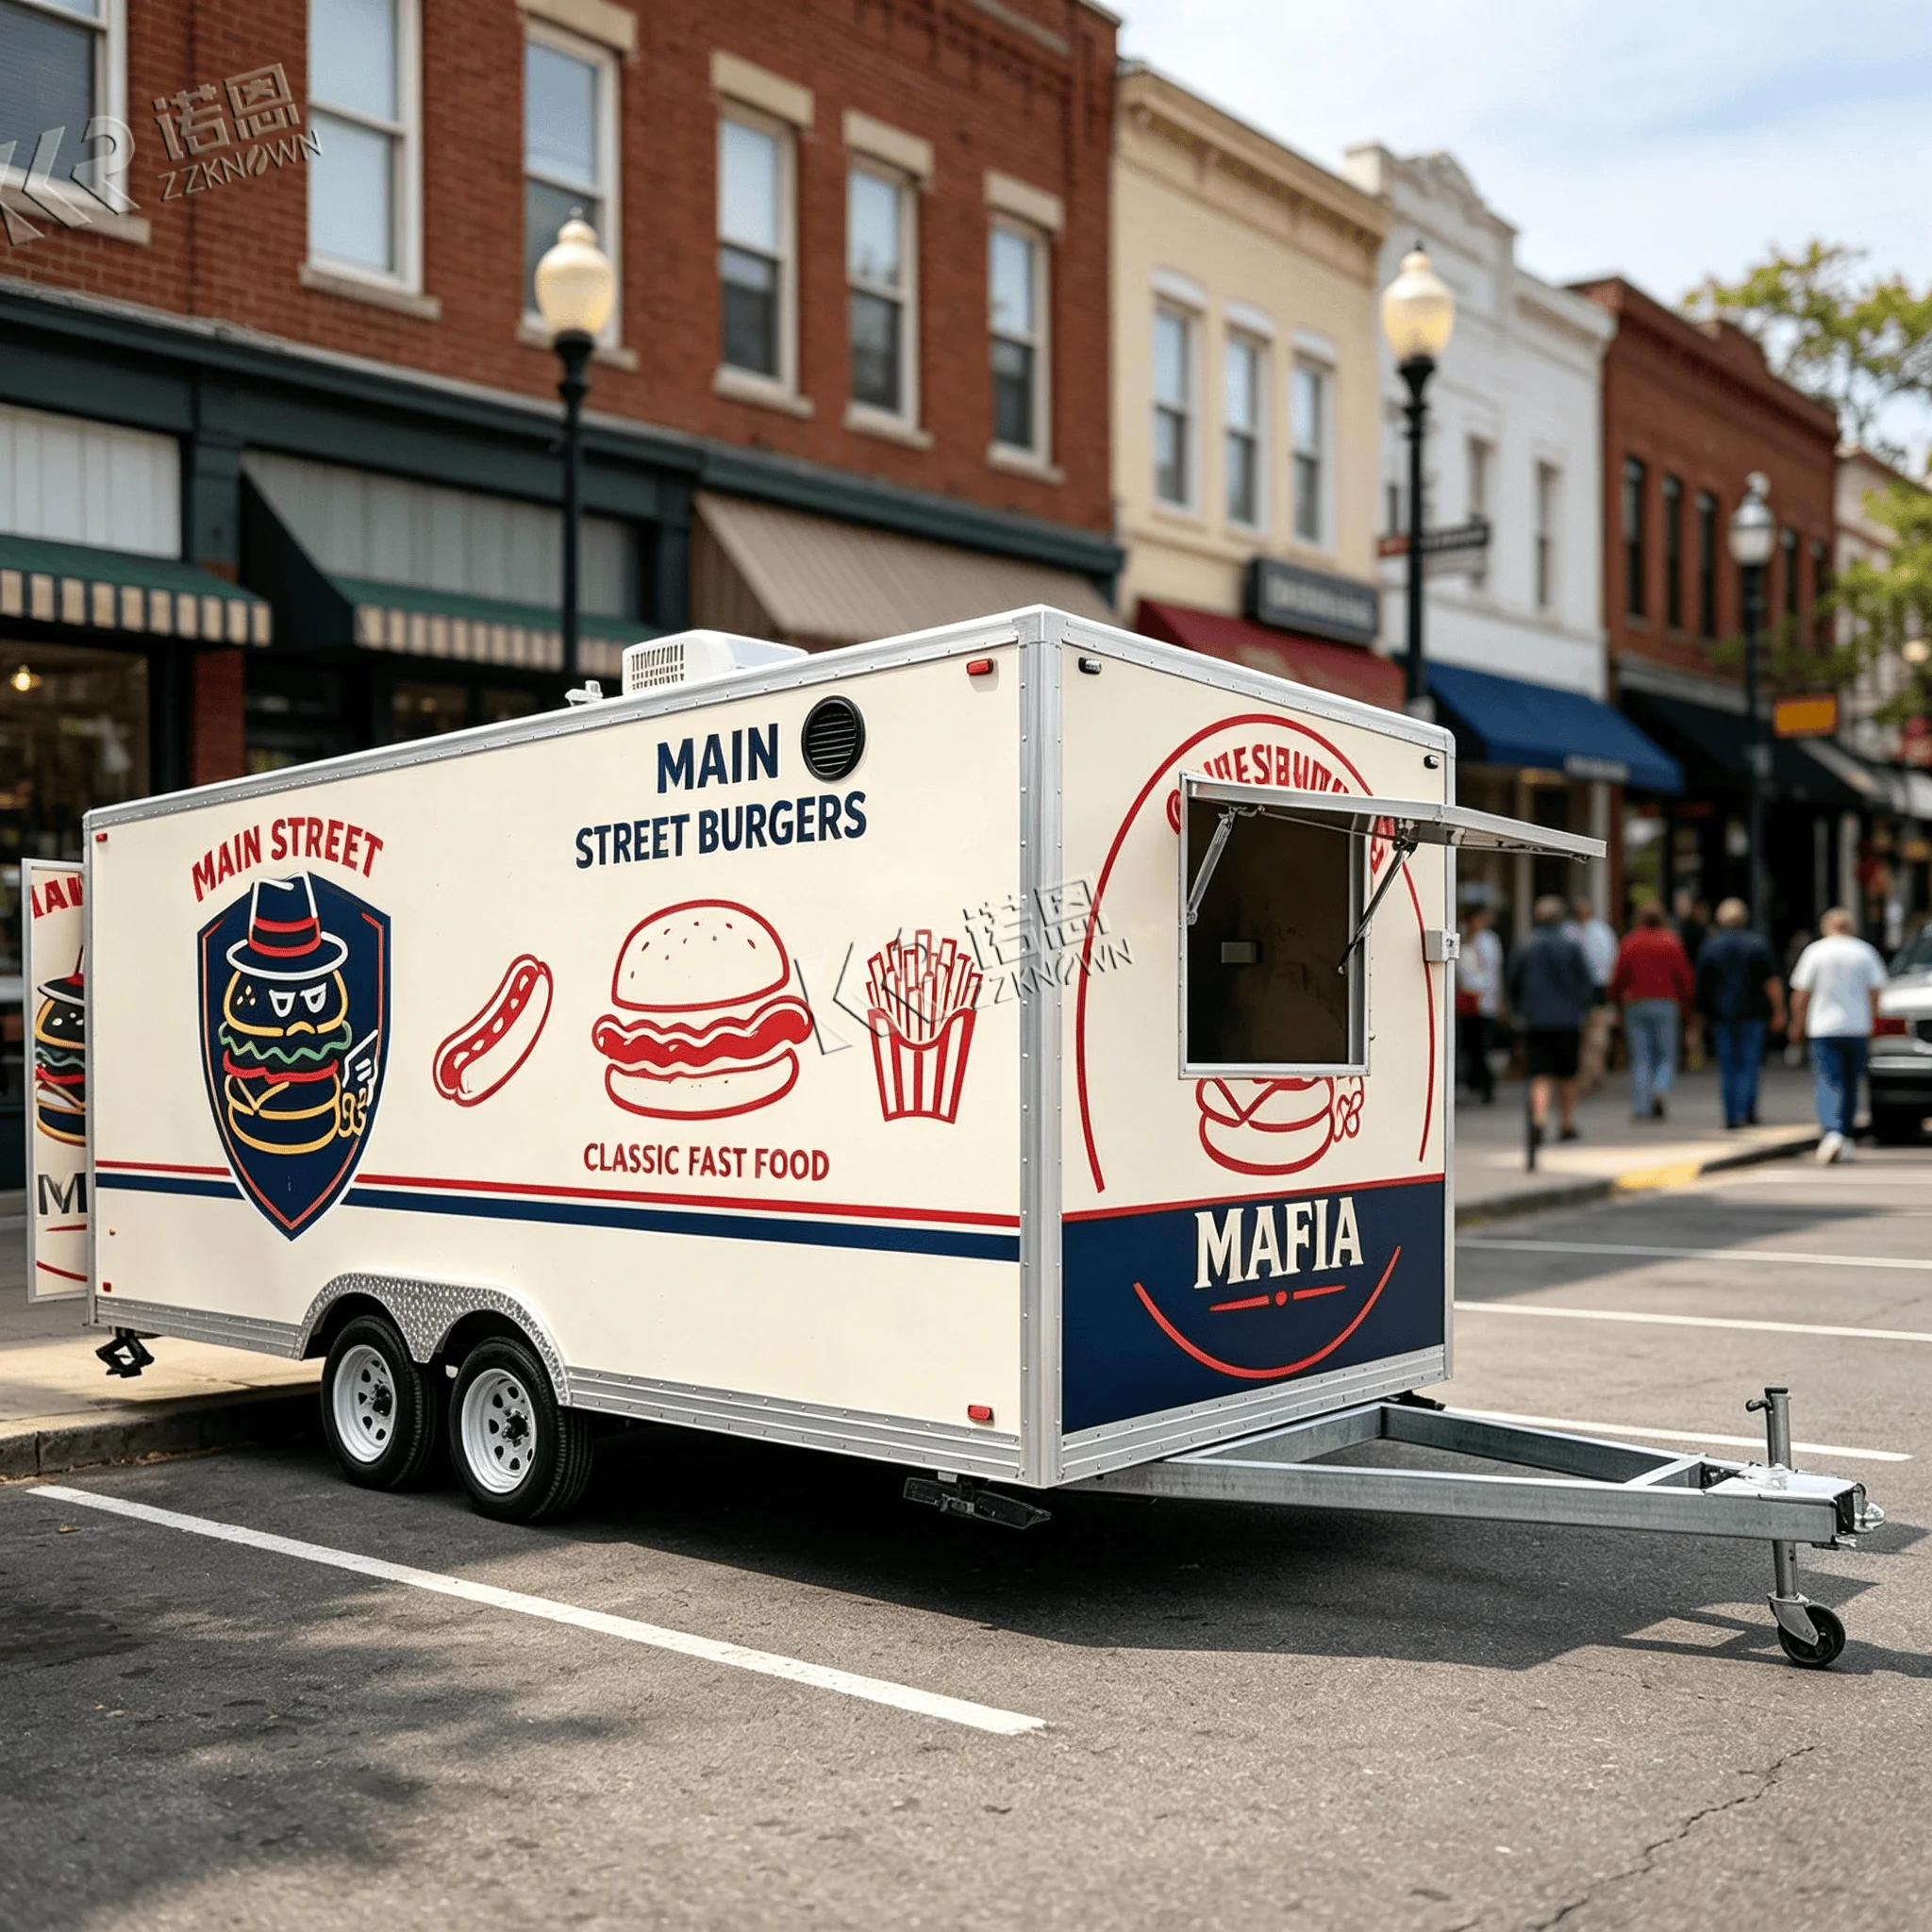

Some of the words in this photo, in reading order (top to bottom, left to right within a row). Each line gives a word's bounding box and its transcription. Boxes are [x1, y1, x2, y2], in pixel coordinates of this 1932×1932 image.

[657, 723, 778, 793] MAIN
[192, 824, 261, 903] MAIN
[271, 817, 384, 878] STREET
[575, 813, 691, 869] STREET
[699, 791, 867, 854] BURGERS
[583, 1142, 679, 1175] CLASSIC
[689, 1145, 747, 1177] FAST
[755, 1148, 829, 1181] FOOD
[1193, 1196, 1364, 1289] MAFIA
